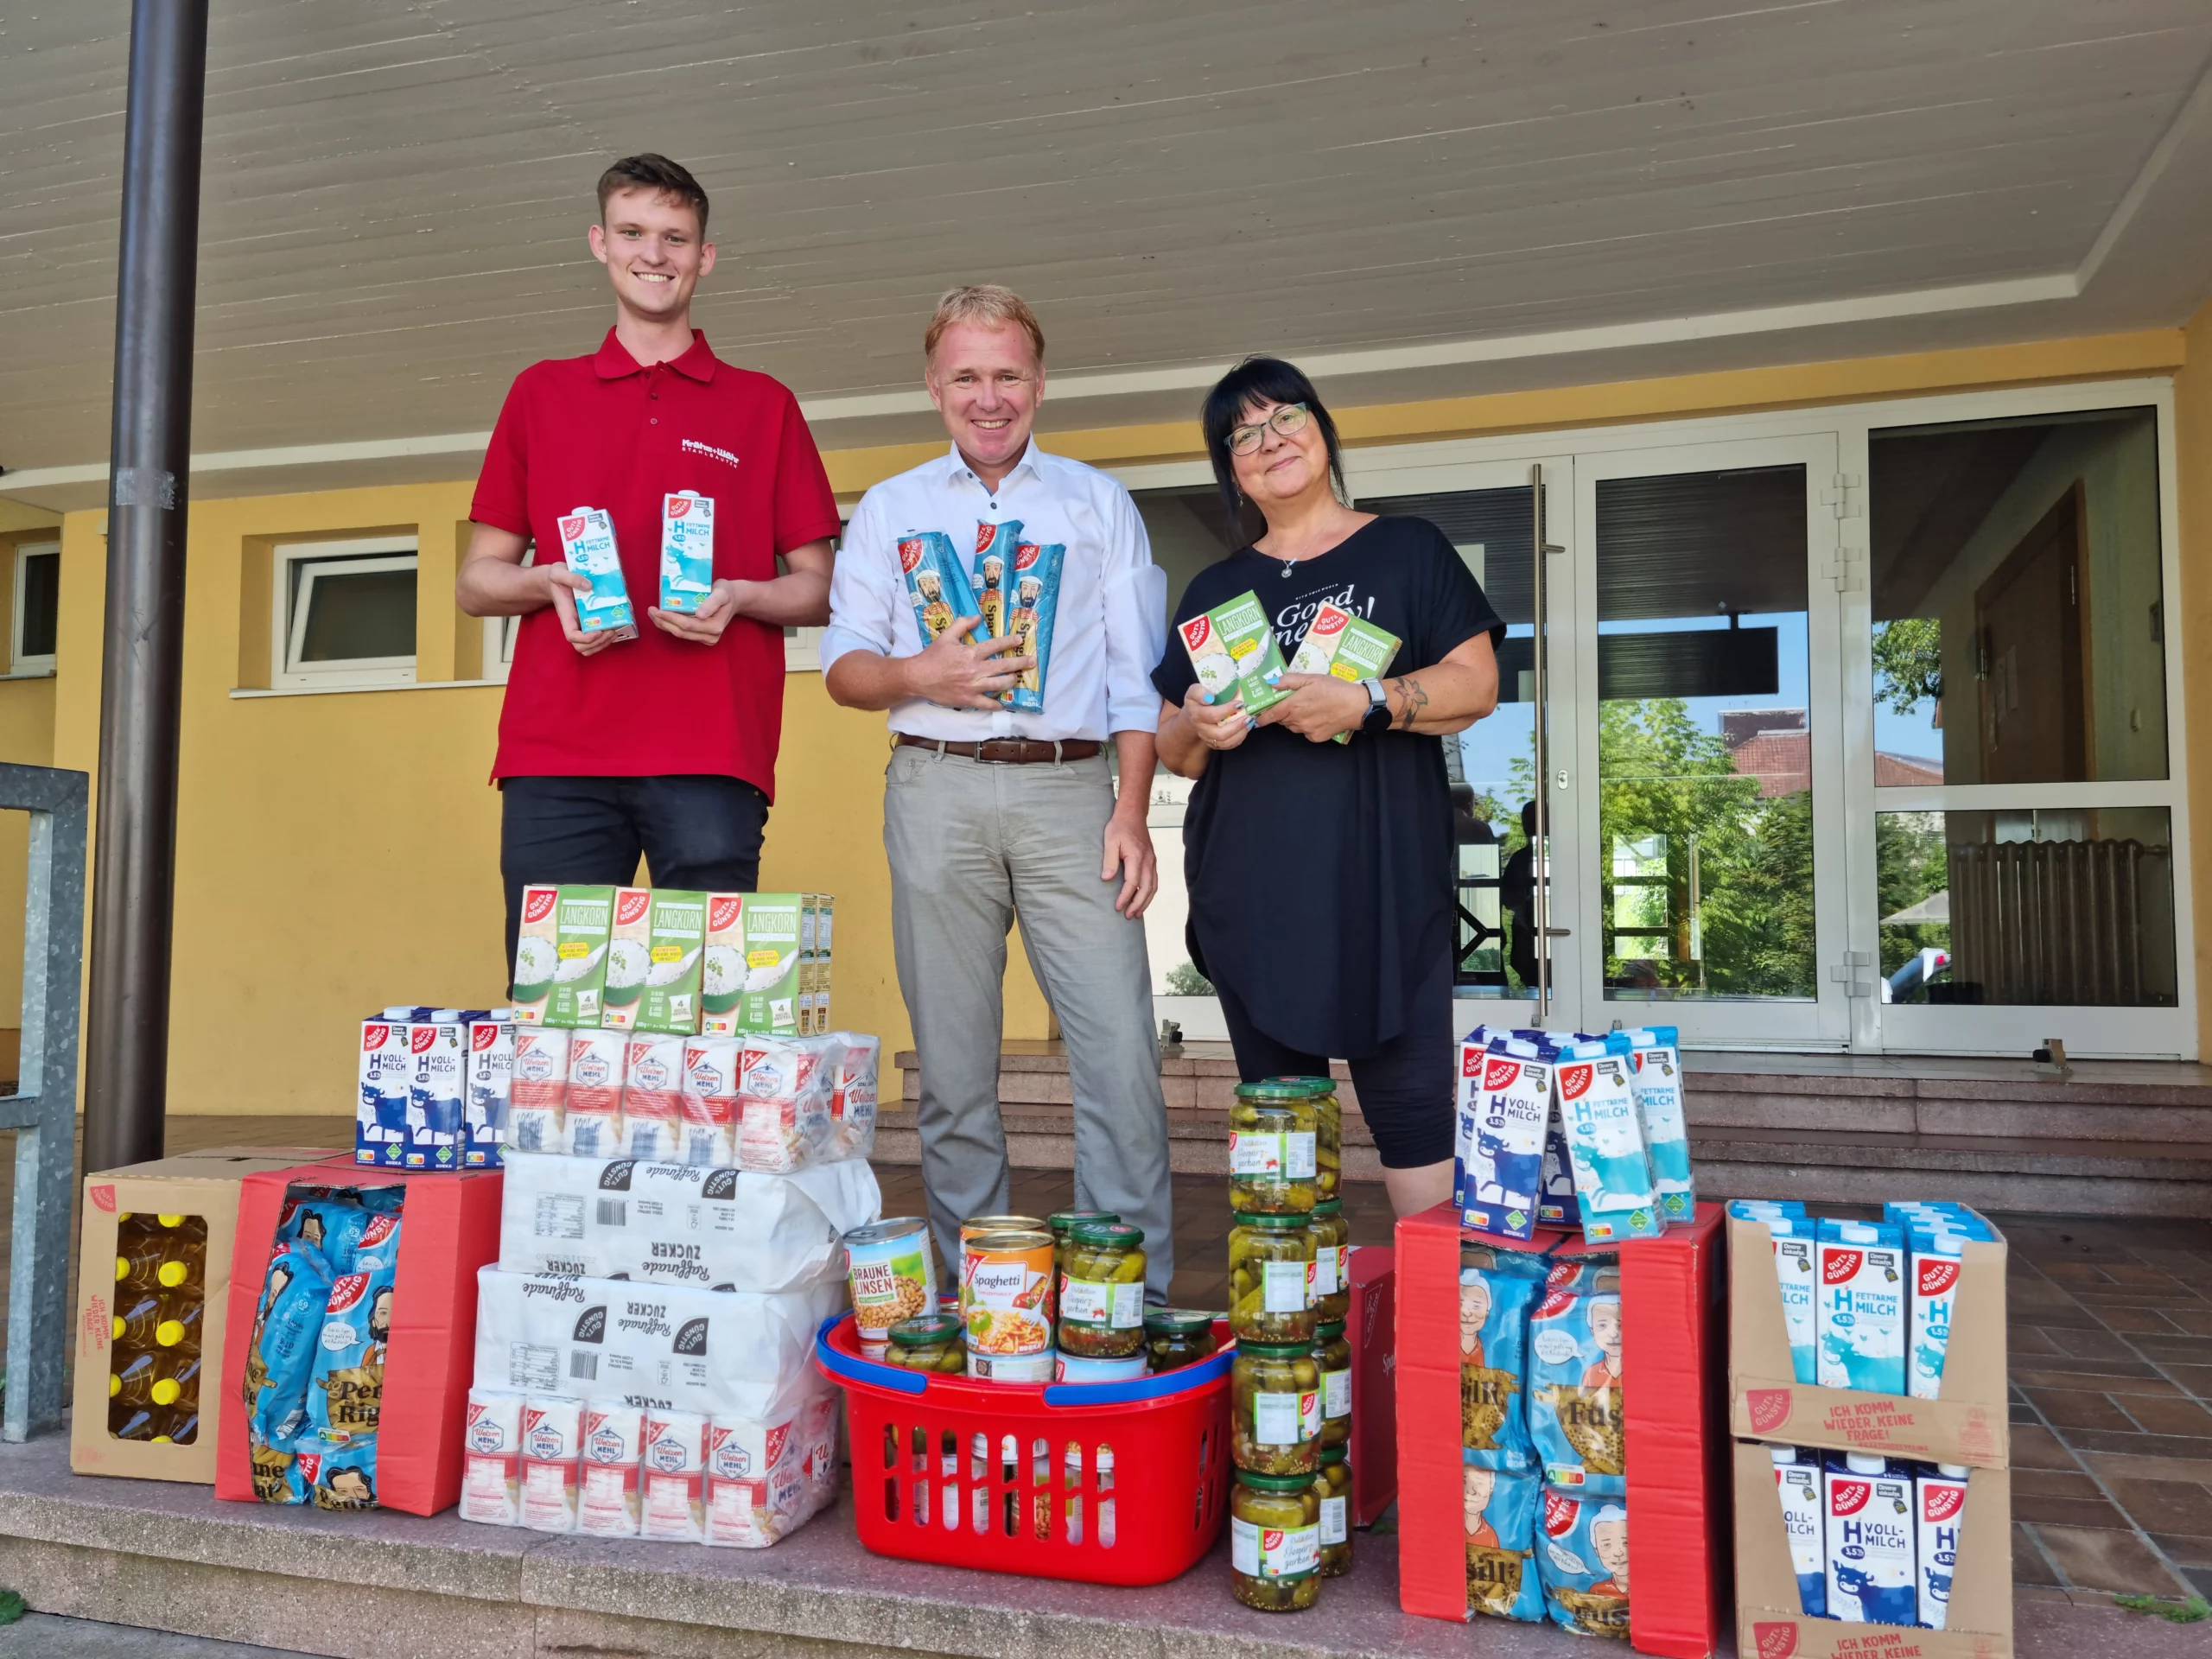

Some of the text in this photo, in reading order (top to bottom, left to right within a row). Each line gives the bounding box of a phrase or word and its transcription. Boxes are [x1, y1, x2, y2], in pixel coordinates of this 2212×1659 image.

[682, 447, 737, 468] STAHLBAUTEN
[670, 501, 689, 516] GÜNSTIG
[567, 519, 582, 538] GÜNSTIG
[674, 521, 685, 533] H
[574, 540, 586, 554] H
[587, 542, 610, 552] MILCH
[1217, 607, 1262, 636] LANGKORN
[1317, 616, 1344, 631] GÜNSTIG
[1192, 620, 1205, 646] GÜNSTIG
[1342, 632, 1387, 664] LANGKORN
[527, 893, 553, 918] GÜNSTIG
[529, 893, 545, 910] GUT&
[620, 896, 645, 921] GÜNSTIG
[621, 895, 638, 912] GUT&
[713, 901, 730, 918] GUT&
[560, 906, 608, 925] LANGKORN
[653, 909, 702, 929] LANGKORN
[712, 900, 738, 928] GÜNSTIG
[747, 912, 797, 932] LANGKORN
[366, 1027, 386, 1048] GÜNSTIG
[414, 1030, 433, 1051] GÜNSTIG
[475, 1027, 494, 1049] GÜNSTIG
[369, 1053, 382, 1070] H
[382, 1063, 406, 1071] MILCH
[383, 1054, 405, 1063] VOLL-
[417, 1055, 429, 1071] H
[432, 1056, 455, 1065] VOLL-
[478, 1053, 491, 1070] H
[523, 1058, 550, 1066] Weizen
[579, 1063, 606, 1071] Weizen
[639, 1066, 664, 1075] Weizen
[694, 1072, 720, 1082] Weizen
[1487, 1065, 1516, 1087] GÜNSTIG
[1489, 1065, 1508, 1078] GUT&
[1565, 1070, 1580, 1087] GUT&
[1566, 1068, 1588, 1096] GÜNSTIG
[1490, 1095, 1507, 1116] H
[1508, 1098, 1541, 1112] VOLL-
[1592, 1097, 1629, 1108] FETTARME
[1641, 1095, 1675, 1106] MILCH
[1507, 1108, 1541, 1123] MILCH
[1574, 1101, 1592, 1122] H
[1593, 1107, 1629, 1121] MILCH
[645, 1165, 701, 1183] Raffinade
[93, 1189, 115, 1208] GÜNSTIG
[1503, 1229, 1525, 1238] EDEKA
[651, 1242, 701, 1260] ZUCKER
[547, 1260, 586, 1274] ZUCKER
[642, 1259, 710, 1281] Raffinade
[1827, 1254, 1847, 1271] GUT&
[1827, 1253, 1857, 1280] GÜNSTIG
[853, 1264, 891, 1281] BRAUNE
[975, 1273, 1020, 1289] Spaghetti
[1922, 1264, 1954, 1292] GÜNSTIG
[1923, 1264, 1944, 1282] GUT&
[522, 1282, 586, 1303] Raffinade
[855, 1277, 893, 1295] LINSEN
[1780, 1283, 1811, 1293] TTARME
[1834, 1288, 1853, 1312] H
[1855, 1292, 1898, 1303] FETTARME
[627, 1301, 667, 1318] ZUCKER
[1855, 1301, 1897, 1316] MILCH
[1929, 1300, 1948, 1324] H
[100, 1315, 110, 1339] KOMM
[579, 1311, 603, 1338] GÜNSTIG
[618, 1316, 671, 1337] Raffinade
[95, 1327, 104, 1351] KEINE
[678, 1323, 704, 1351] GÜNSTIG
[1754, 1395, 1773, 1415] GUT&
[1755, 1393, 1783, 1426] GÜNSTIG
[1828, 1400, 1895, 1418] ICH KOMM
[1876, 1412, 1915, 1427] KEINE
[474, 1427, 500, 1438] Weizen
[533, 1433, 560, 1444] Weizen
[1847, 1428, 1891, 1441] FRAGE!
[537, 1442, 555, 1451] MEHL
[594, 1437, 620, 1446] Weizen
[596, 1446, 616, 1454] MEHL
[656, 1446, 683, 1458] Weizen
[659, 1455, 678, 1464] MEHL
[719, 1452, 747, 1462] Weizen
[723, 1460, 742, 1469] MEHL
[1834, 1485, 1866, 1511] GÜNSTIG
[1835, 1485, 1856, 1502] GUT&
[1929, 1490, 1949, 1509] GUT&
[1928, 1490, 1960, 1517] GÜNSTIG
[1784, 1510, 1814, 1523] OLL-
[1843, 1520, 1862, 1544] H
[1865, 1522, 1904, 1536] VOLL-
[1865, 1535, 1906, 1548] MILCH
[1936, 1526, 1955, 1550] H
[1761, 1628, 1780, 1648] GUT&
[1762, 1626, 1790, 1659] GÜNSTIG
[1836, 1632, 1902, 1651] ICH KOMM
[1886, 1645, 1922, 1659] KEINE
